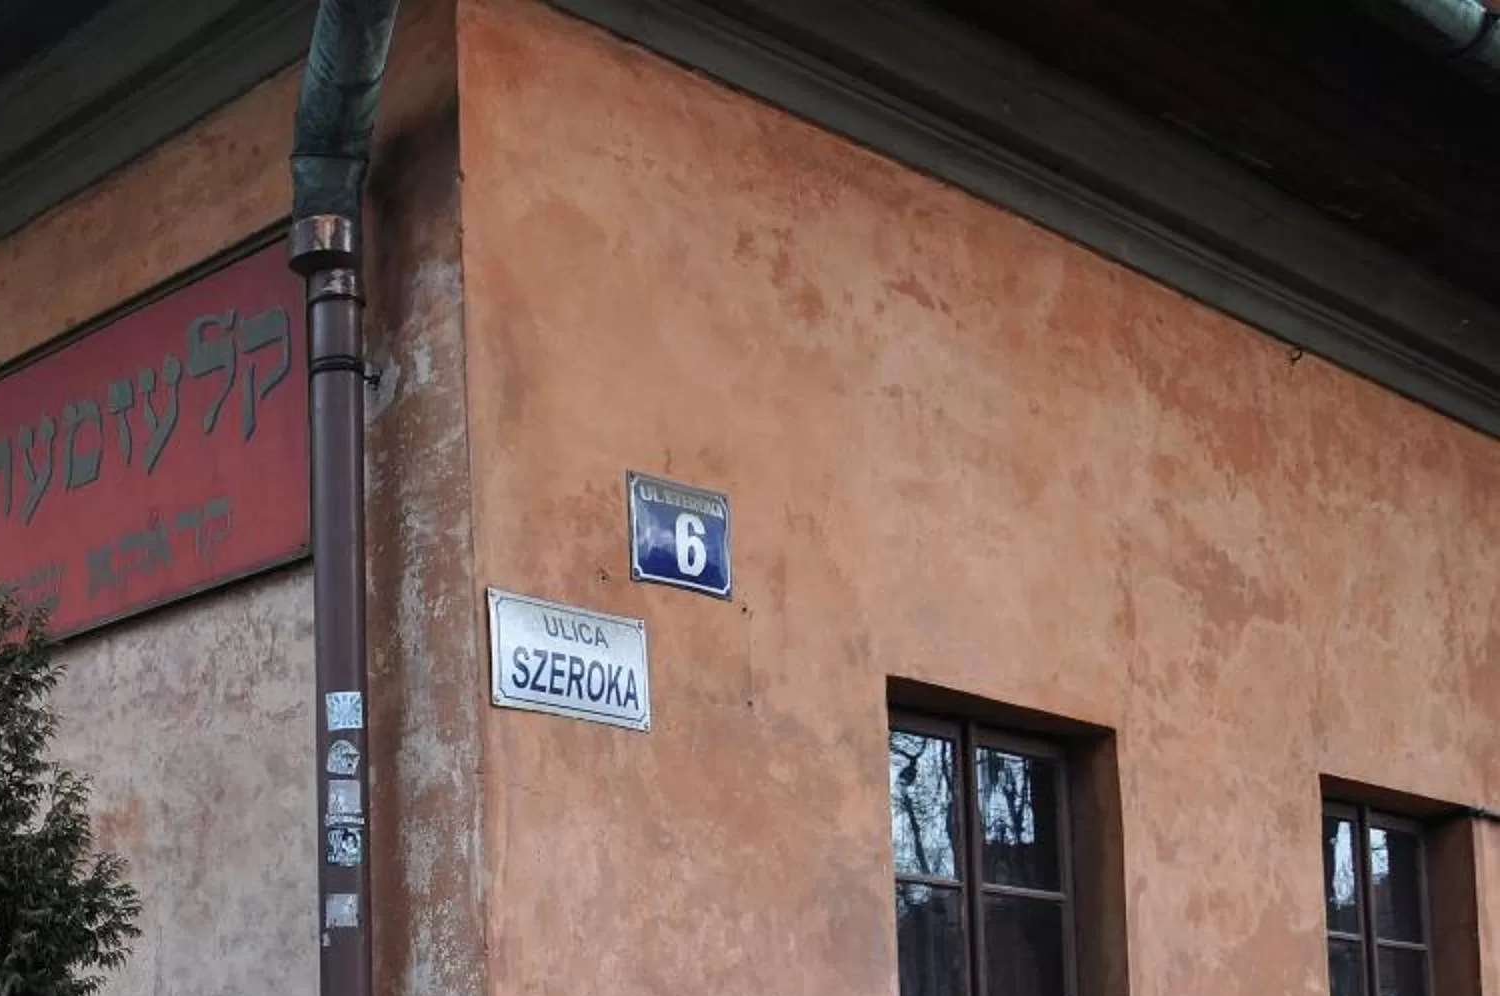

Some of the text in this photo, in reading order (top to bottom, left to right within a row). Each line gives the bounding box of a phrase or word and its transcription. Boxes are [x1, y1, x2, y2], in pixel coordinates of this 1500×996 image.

[675, 512, 707, 577] 6
[544, 614, 609, 648] ULICA
[511, 646, 640, 710] SZEROKA
